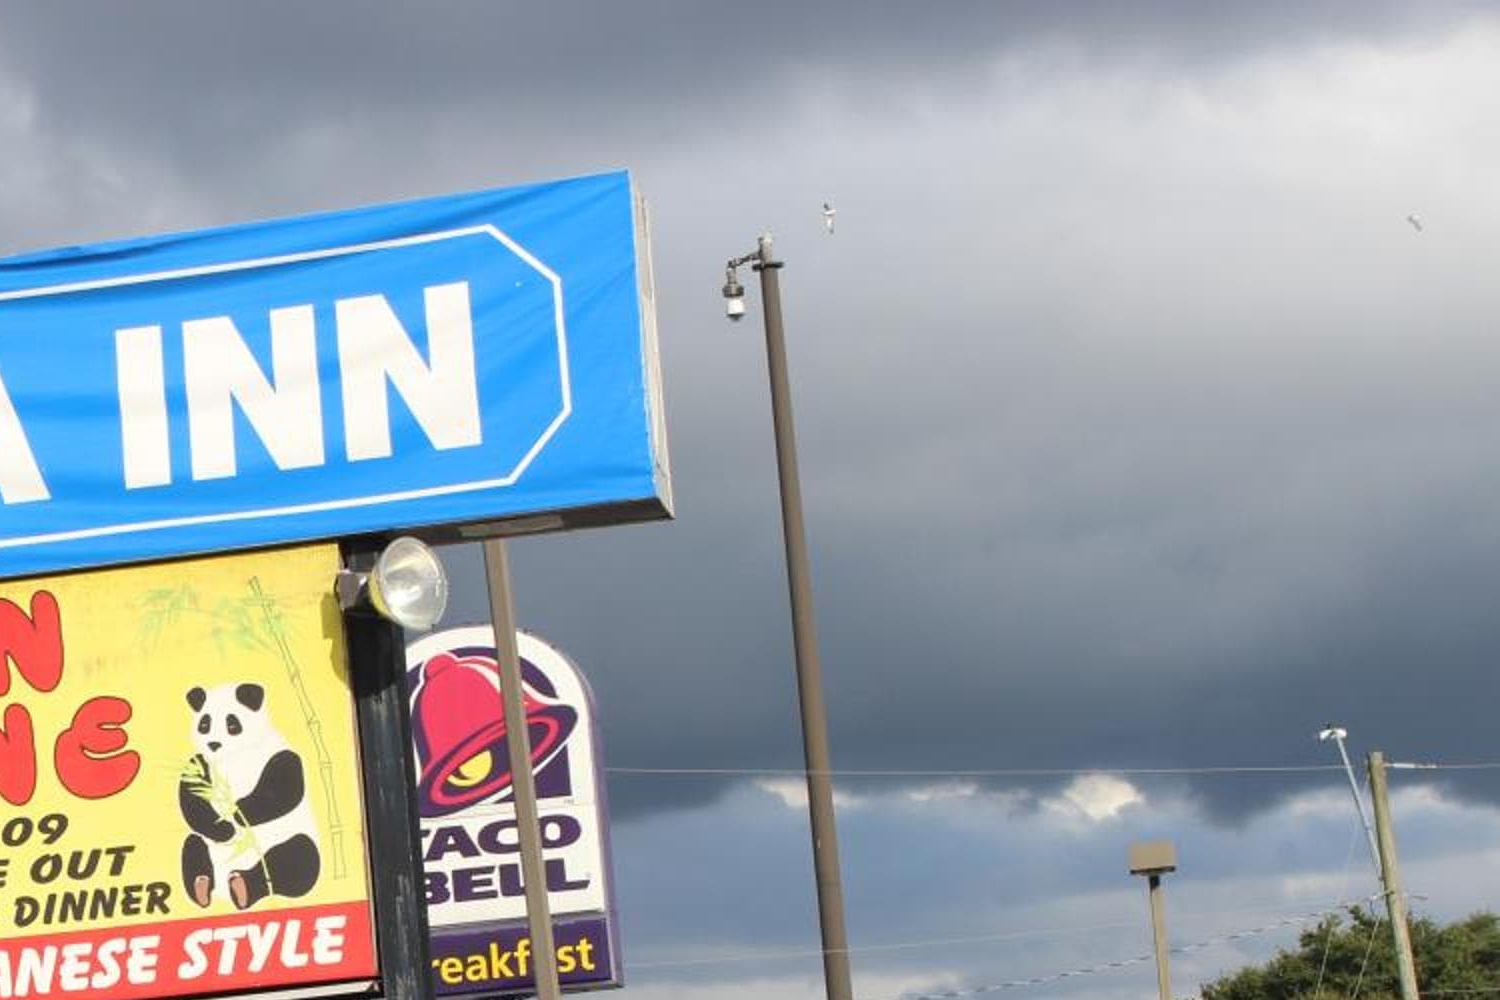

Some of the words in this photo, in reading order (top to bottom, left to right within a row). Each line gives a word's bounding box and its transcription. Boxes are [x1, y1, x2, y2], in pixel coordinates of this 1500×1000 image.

[115, 281, 482, 489] INN
[420, 814, 582, 863] ACO
[29, 845, 136, 884] OUT
[423, 857, 591, 905] BELL
[14, 881, 172, 928] DINNER
[177, 914, 347, 980] STYLE
